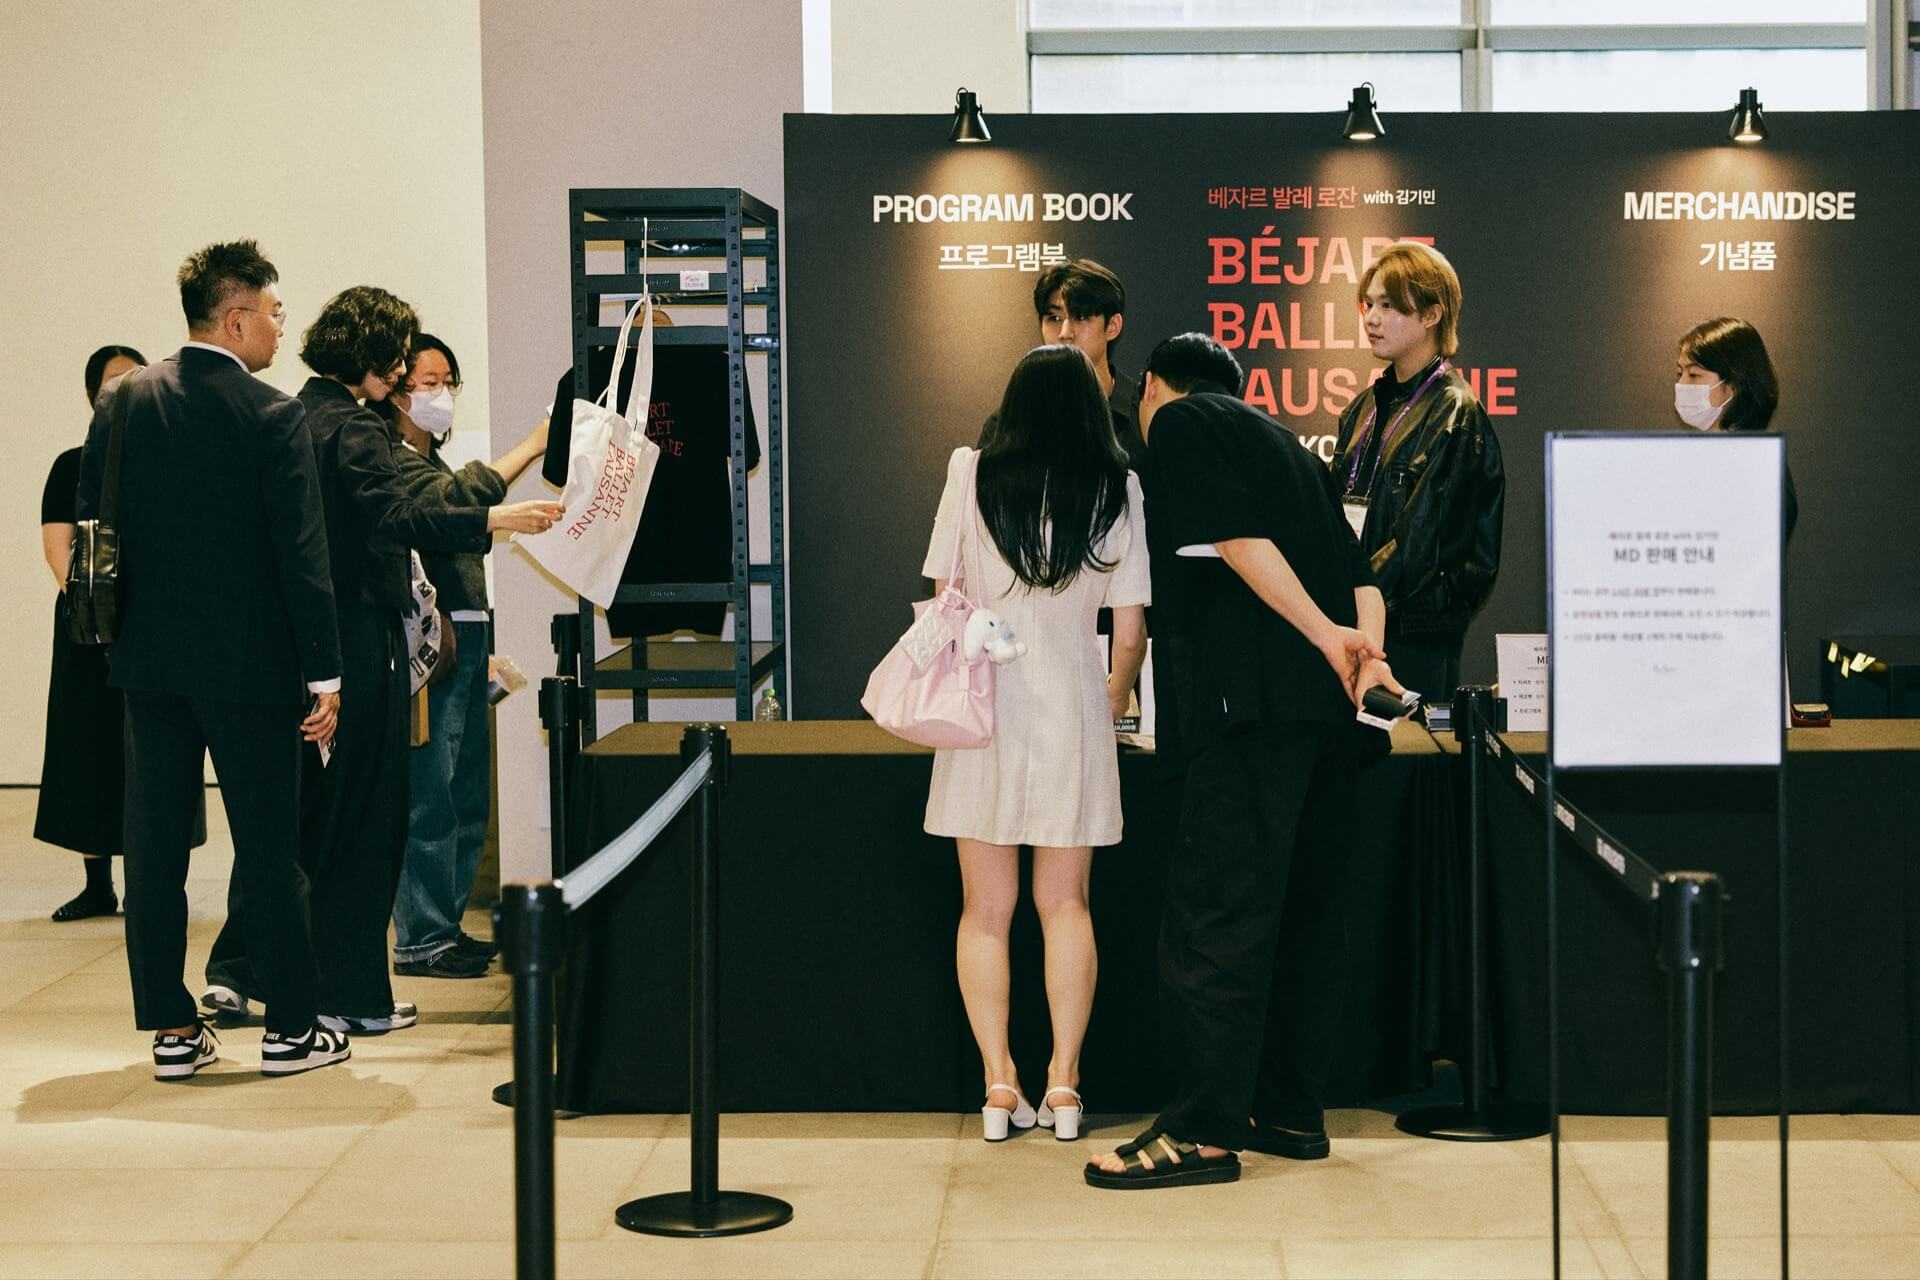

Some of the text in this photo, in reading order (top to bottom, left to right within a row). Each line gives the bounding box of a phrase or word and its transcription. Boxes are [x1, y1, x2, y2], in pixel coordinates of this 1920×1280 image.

[873, 192, 1134, 223] PROGRAM BOOK
[1208, 186, 1436, 209] 베자르 발레 로잔 with 김기민
[1623, 191, 1856, 221] MERCHANDISE
[938, 242, 1068, 272] 프로그램북
[1207, 225, 1436, 285] BÉJA
[1699, 240, 1777, 271] 기념품
[1207, 302, 1372, 349] BALL
[567, 440, 615, 540] LAUSANNE
[604, 446, 625, 519] BALLET
[1613, 546, 1715, 565] MD 판매 안내
[163, 1035, 178, 1043] NIKE
